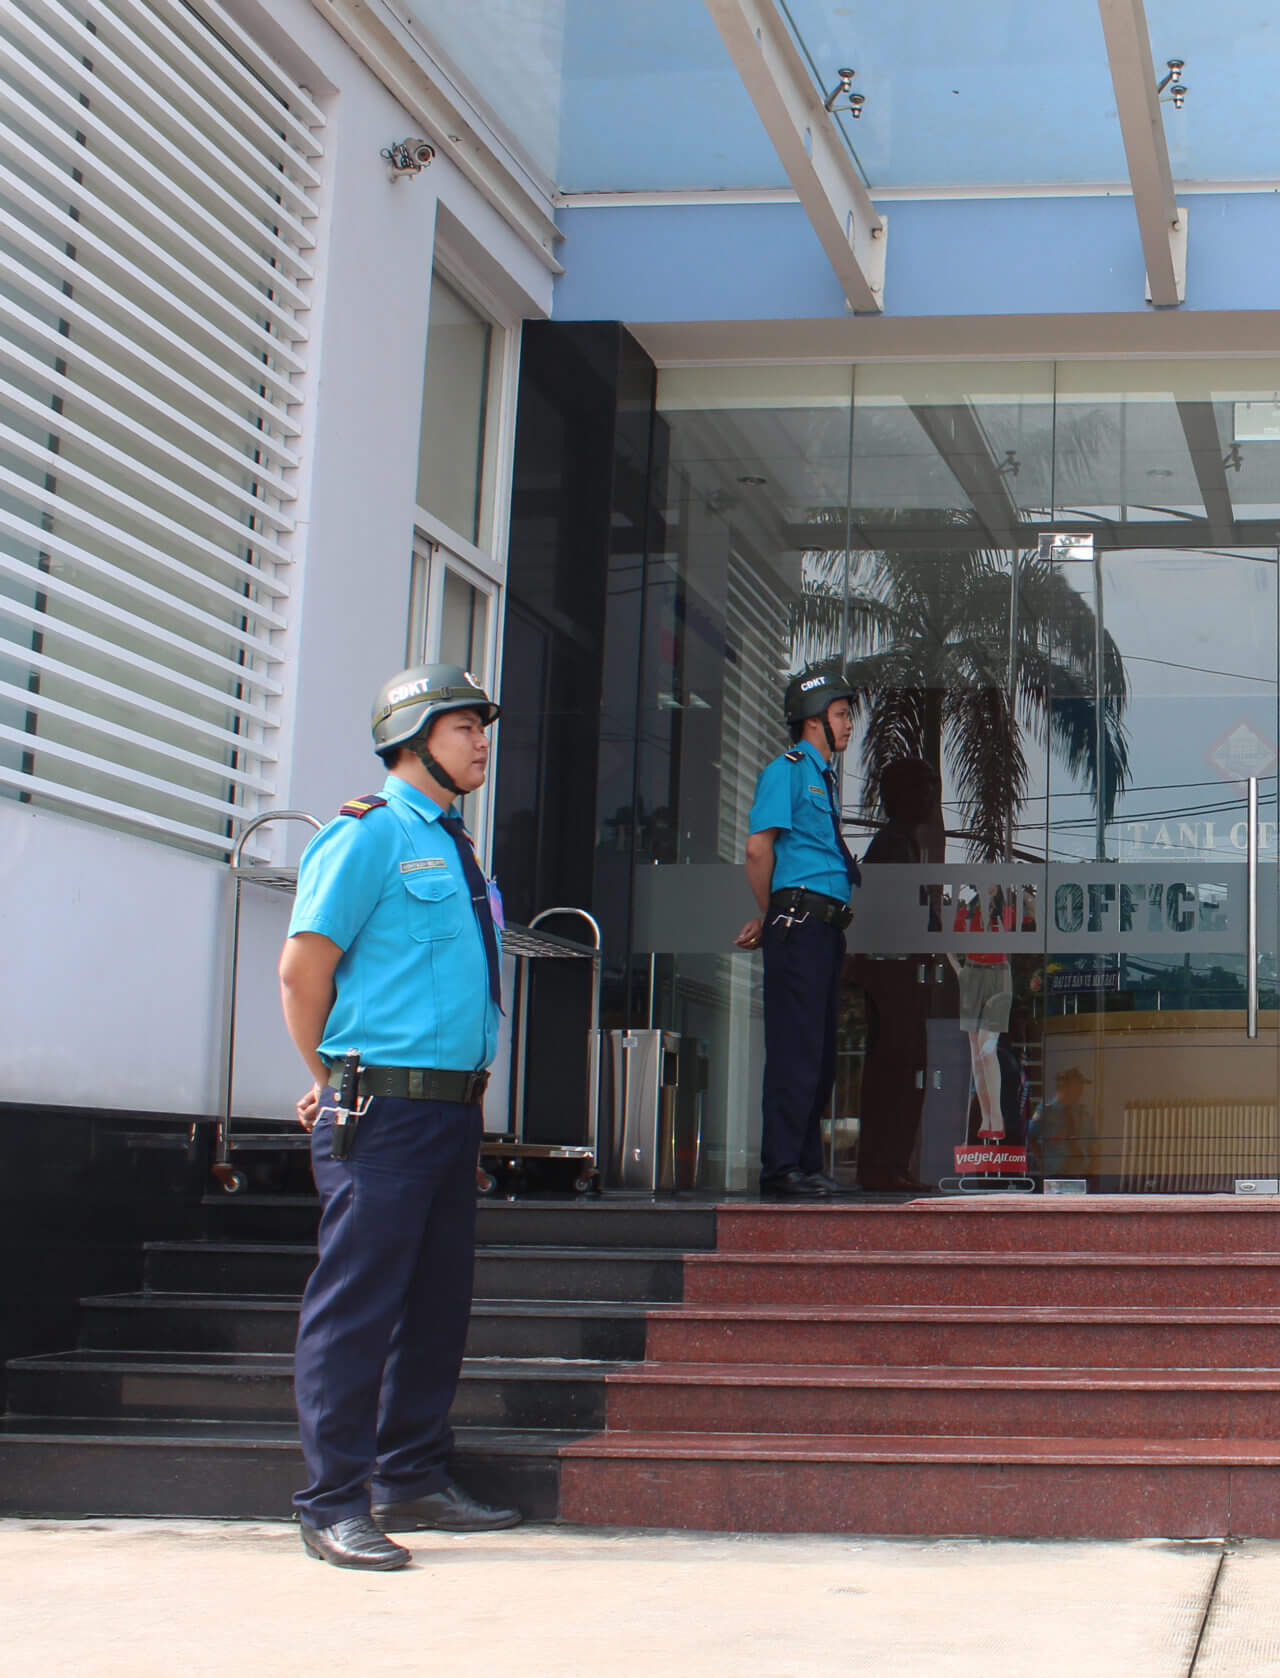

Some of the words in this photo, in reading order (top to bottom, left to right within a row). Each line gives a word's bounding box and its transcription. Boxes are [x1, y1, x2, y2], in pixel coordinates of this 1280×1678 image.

[1127, 821, 1217, 850] TANI
[919, 883, 1039, 932] TANI
[1054, 882, 1230, 933] OFFICE
